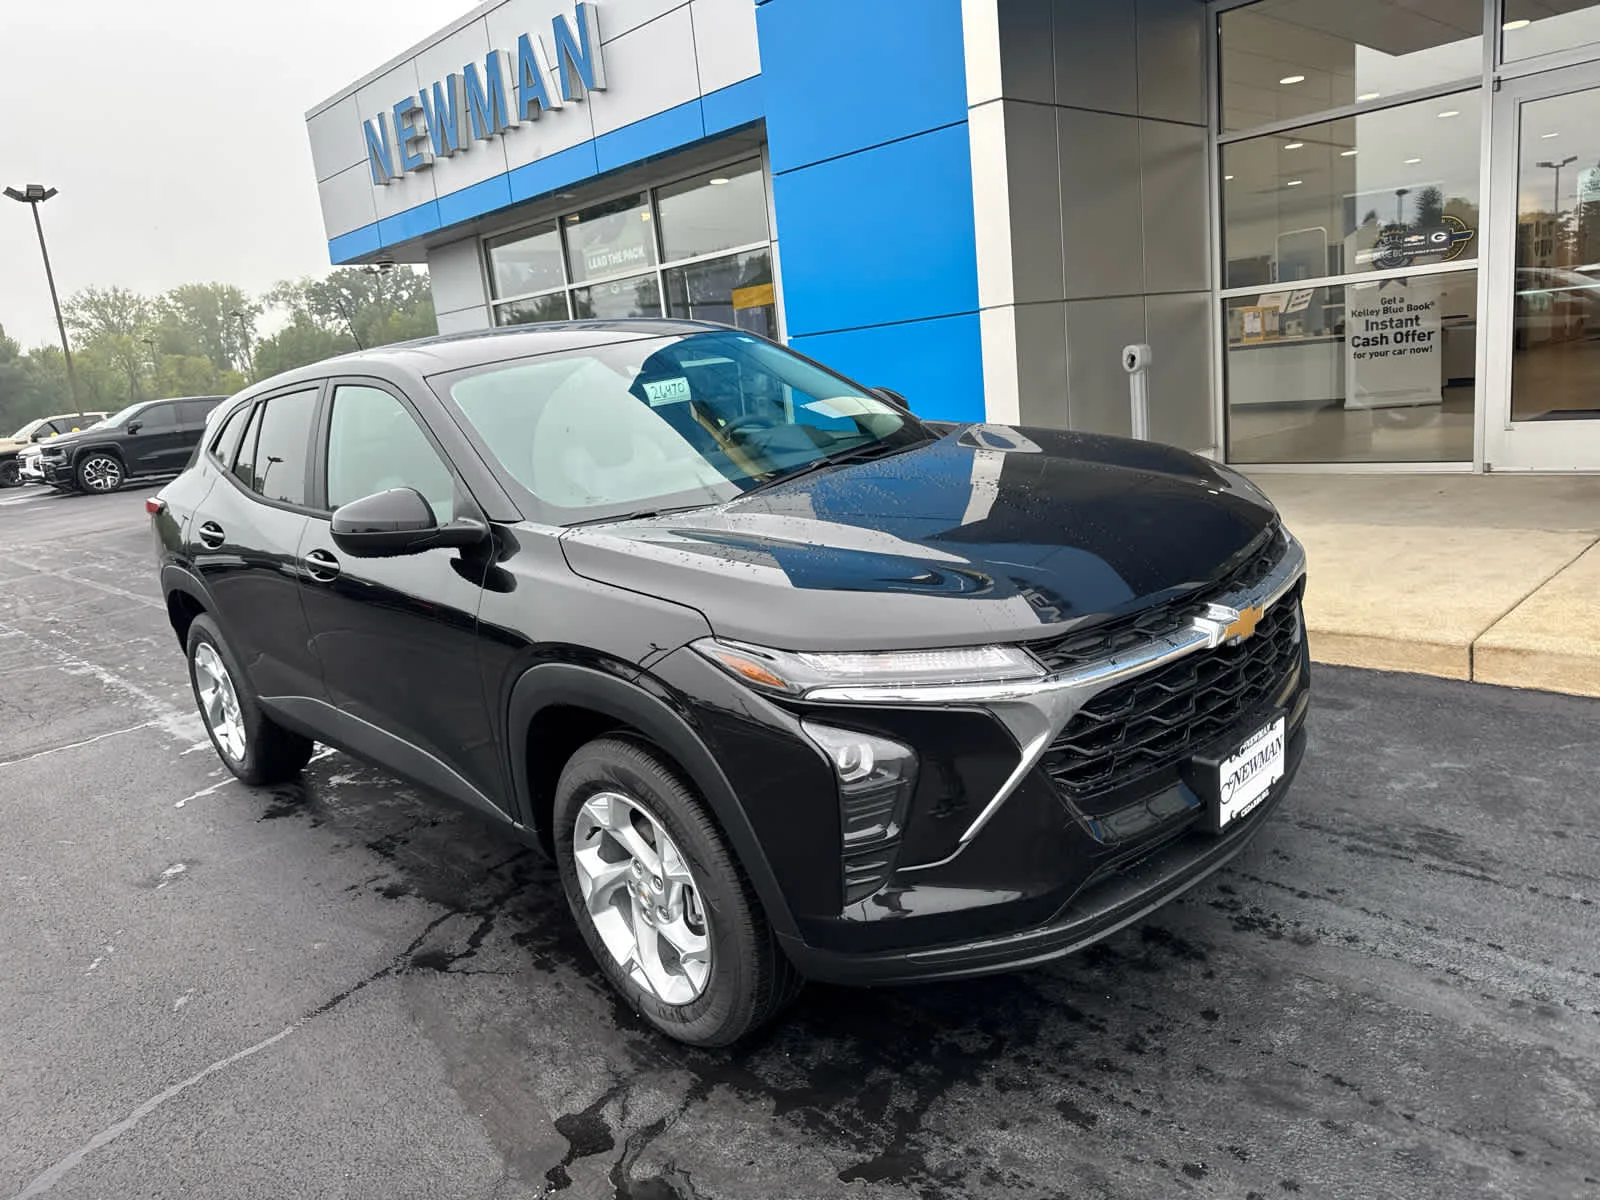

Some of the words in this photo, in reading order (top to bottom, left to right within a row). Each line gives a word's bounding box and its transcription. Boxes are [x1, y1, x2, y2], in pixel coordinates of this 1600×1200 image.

[364, 2, 607, 186] NEWMAN
[1381, 296, 1396, 305] Get
[1351, 307, 1380, 318] Kelley
[1383, 305, 1404, 315] Blue
[1365, 314, 1421, 332] Instant
[1351, 333, 1389, 348] Cash
[1393, 329, 1436, 344] Offer
[1353, 351, 1367, 359] for
[1369, 349, 1390, 359] your
[1392, 347, 1407, 355] car
[1409, 345, 1433, 355] now!
[650, 382, 685, 400] 26470
[1220, 734, 1283, 805] NEWMAN
